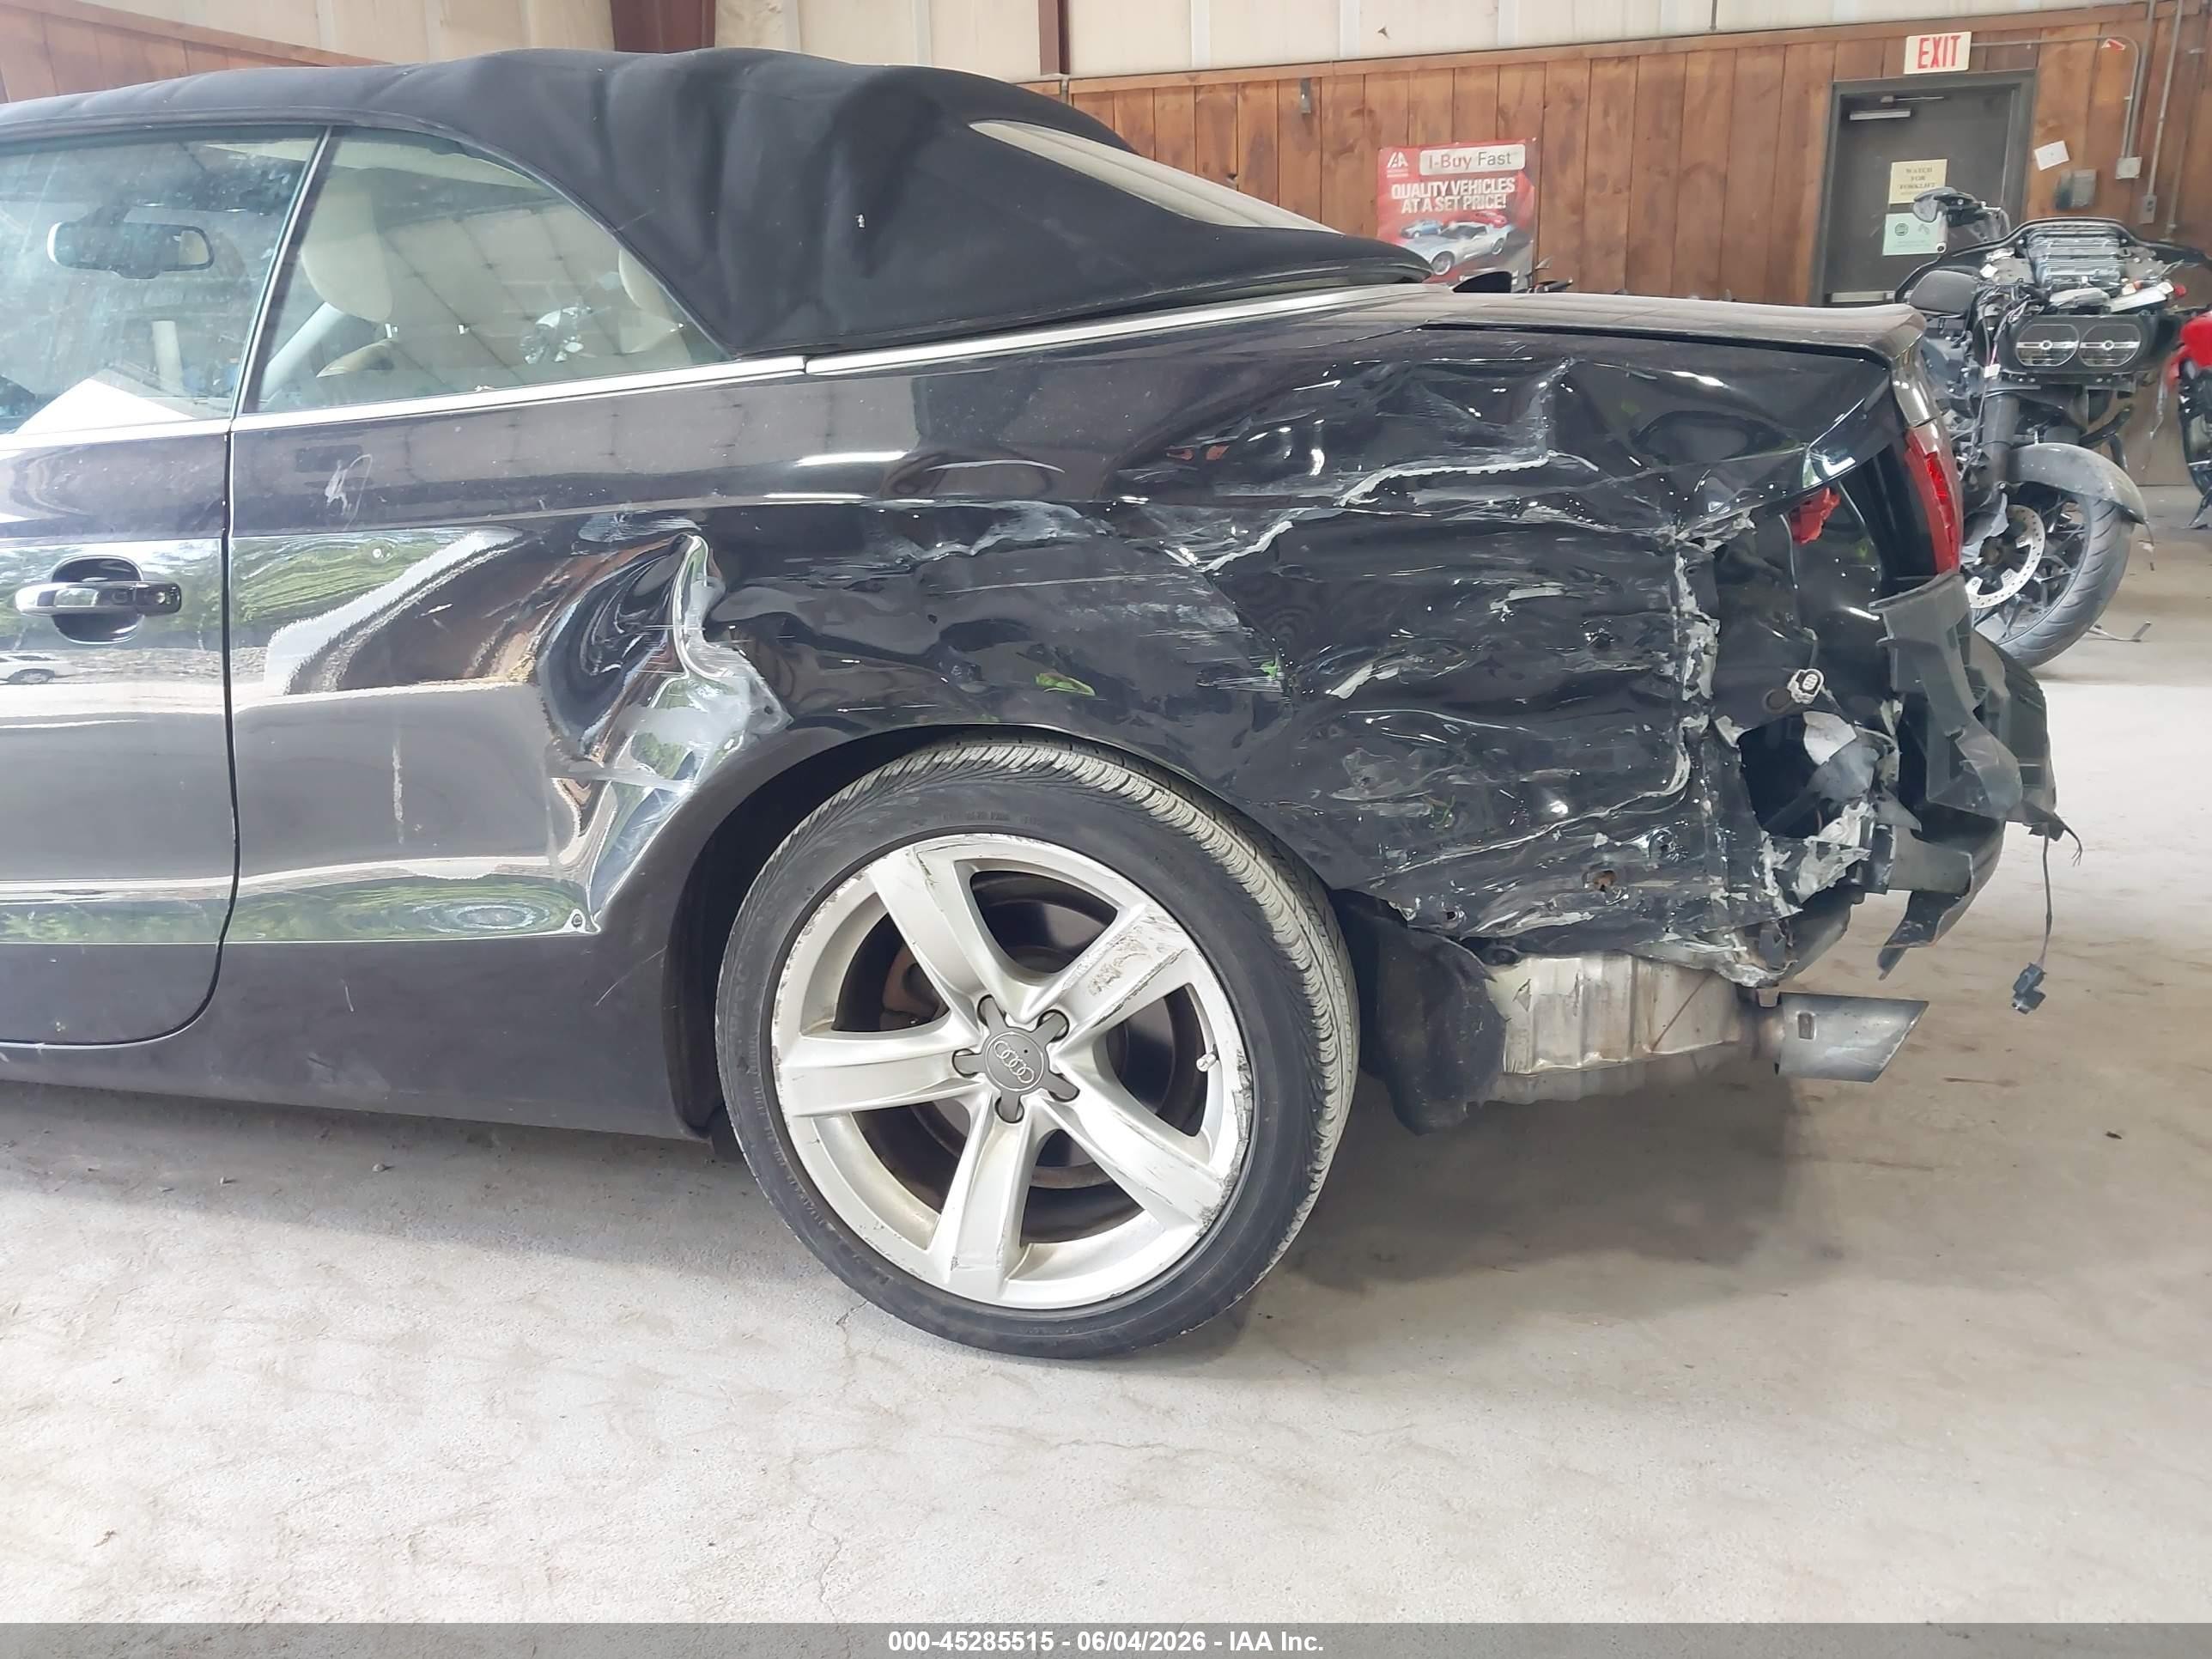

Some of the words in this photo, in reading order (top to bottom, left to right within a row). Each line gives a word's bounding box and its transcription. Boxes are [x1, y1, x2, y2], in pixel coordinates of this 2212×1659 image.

[1917, 35, 1961, 69] EXIT
[1428, 154, 1472, 170] I-Buy
[1478, 151, 1512, 166] Fast
[1391, 180, 1449, 199] QUALITY
[1450, 177, 1516, 196] VEHICLES
[1401, 198, 1419, 214] AT
[1422, 197, 1432, 213] A
[1435, 196, 1461, 212] SET
[1463, 193, 1507, 210] PRICE!
